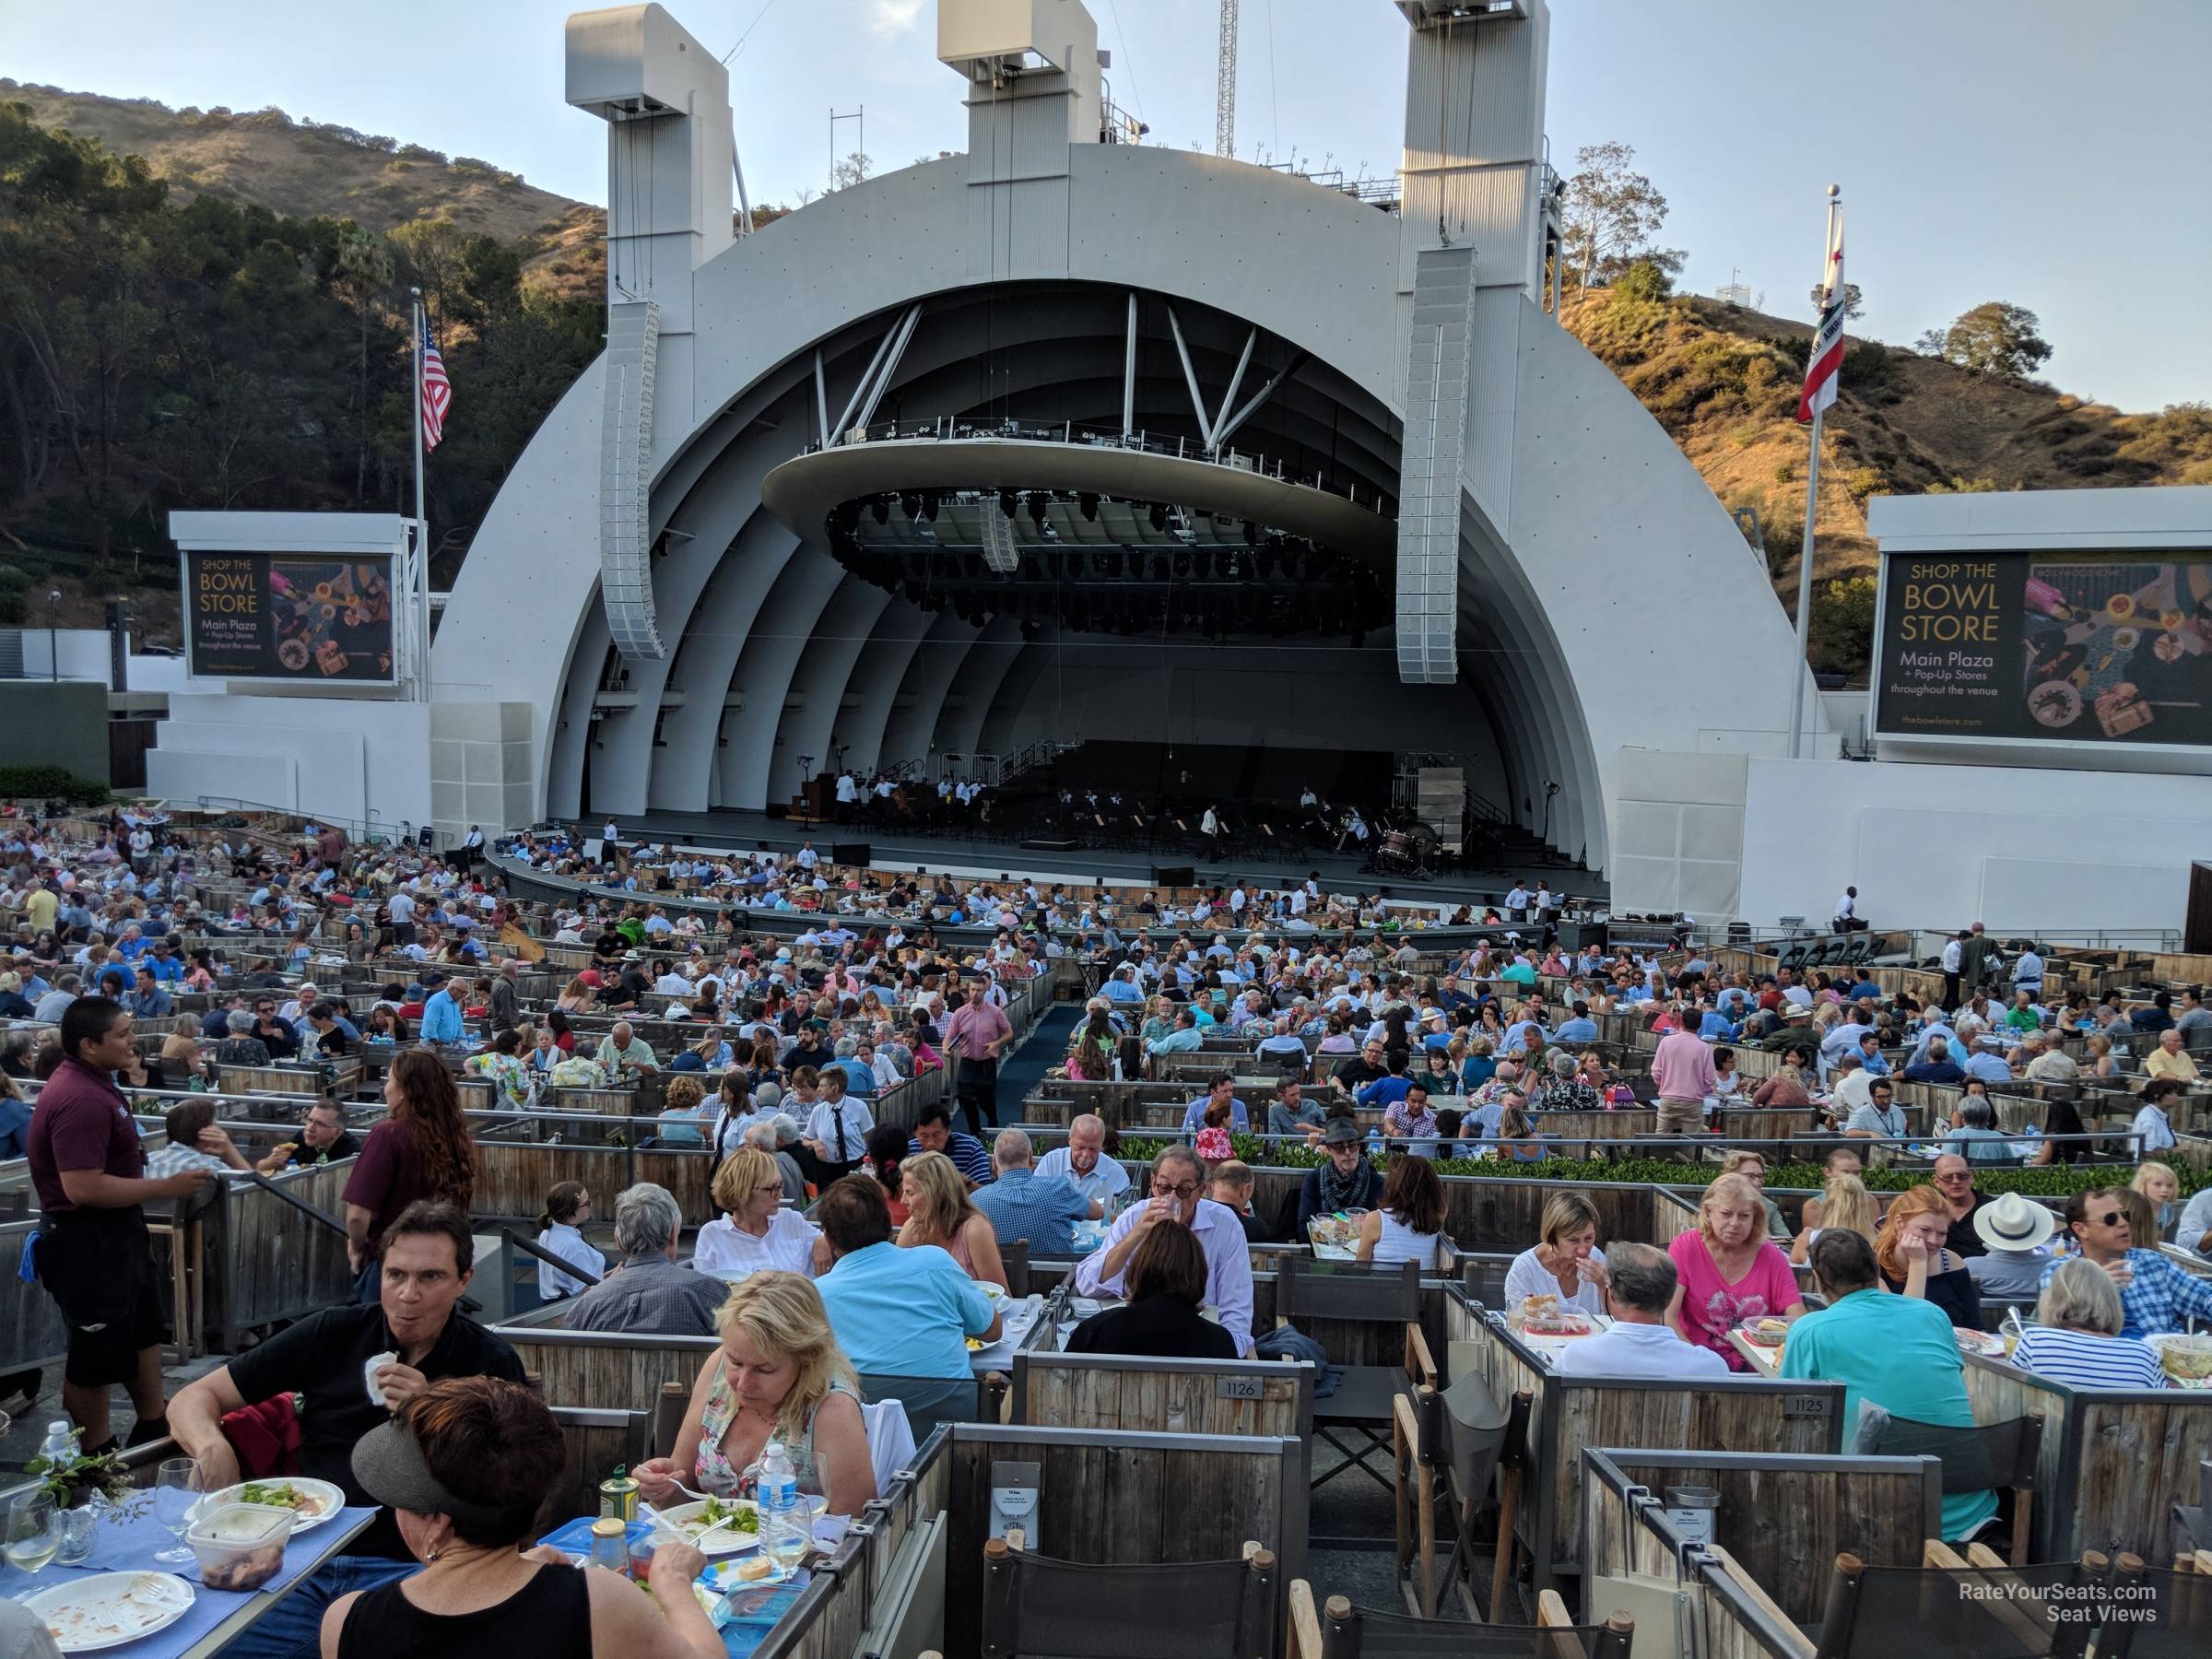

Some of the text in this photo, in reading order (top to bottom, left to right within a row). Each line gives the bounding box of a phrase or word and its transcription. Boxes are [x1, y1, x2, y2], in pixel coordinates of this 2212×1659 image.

[202, 559, 253, 571] SHOP THE
[1911, 563, 1997, 580] SHOP THE
[200, 573, 257, 591] BOWL
[200, 594, 257, 613] STORE
[1904, 583, 2000, 610] BOWL
[202, 618, 257, 630] Main Plaza
[1900, 615, 1999, 641] STORE
[1900, 651, 1994, 667] Main Plaza
[1914, 669, 1952, 682] Pop-Up
[1955, 669, 1987, 680] Stores
[1890, 682, 1998, 696] throughout the venue
[1902, 715, 1983, 726] thebowlstore.com
[1227, 1382, 1254, 1394] 1126
[1795, 1399, 1823, 1412] 1125
